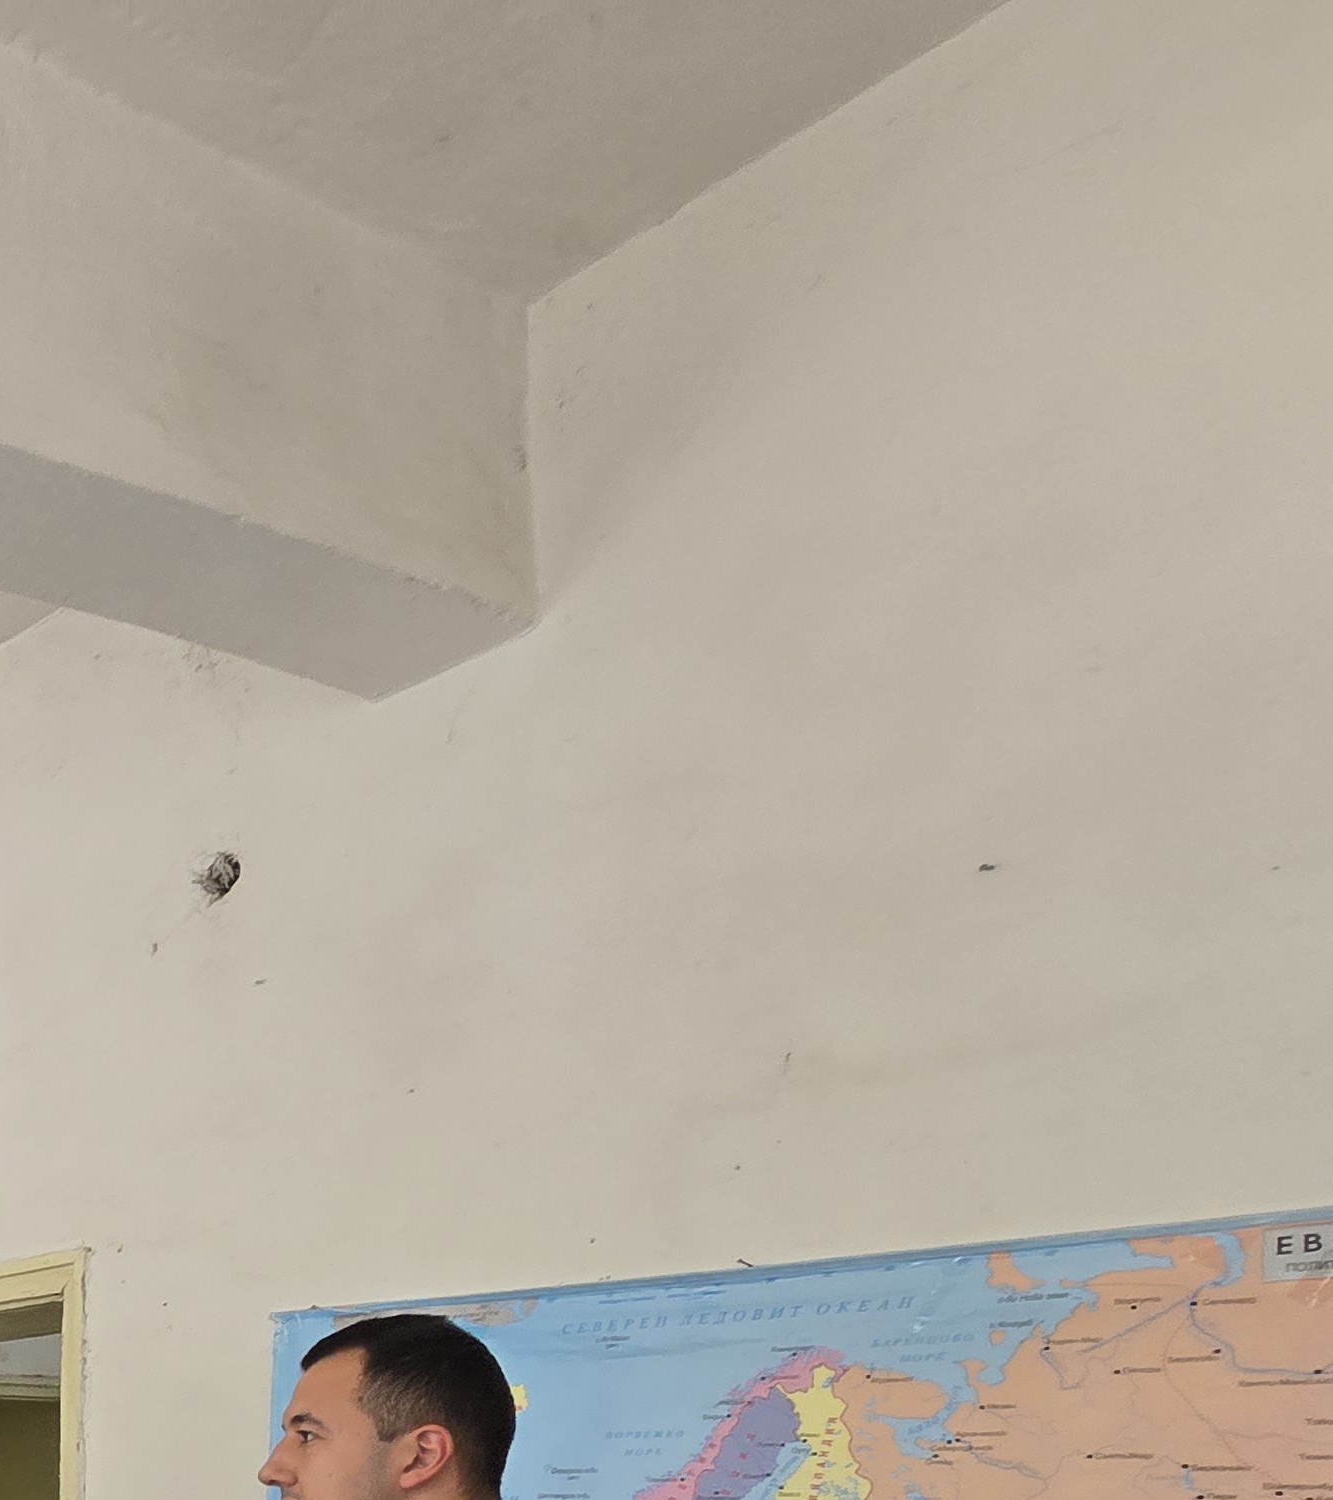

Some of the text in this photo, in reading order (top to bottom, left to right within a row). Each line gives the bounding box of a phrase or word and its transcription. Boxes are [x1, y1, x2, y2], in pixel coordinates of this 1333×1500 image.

[561, 1296, 915, 1335] СЕВЕРЕН ЛЕДОВИТ ОКЕАН
